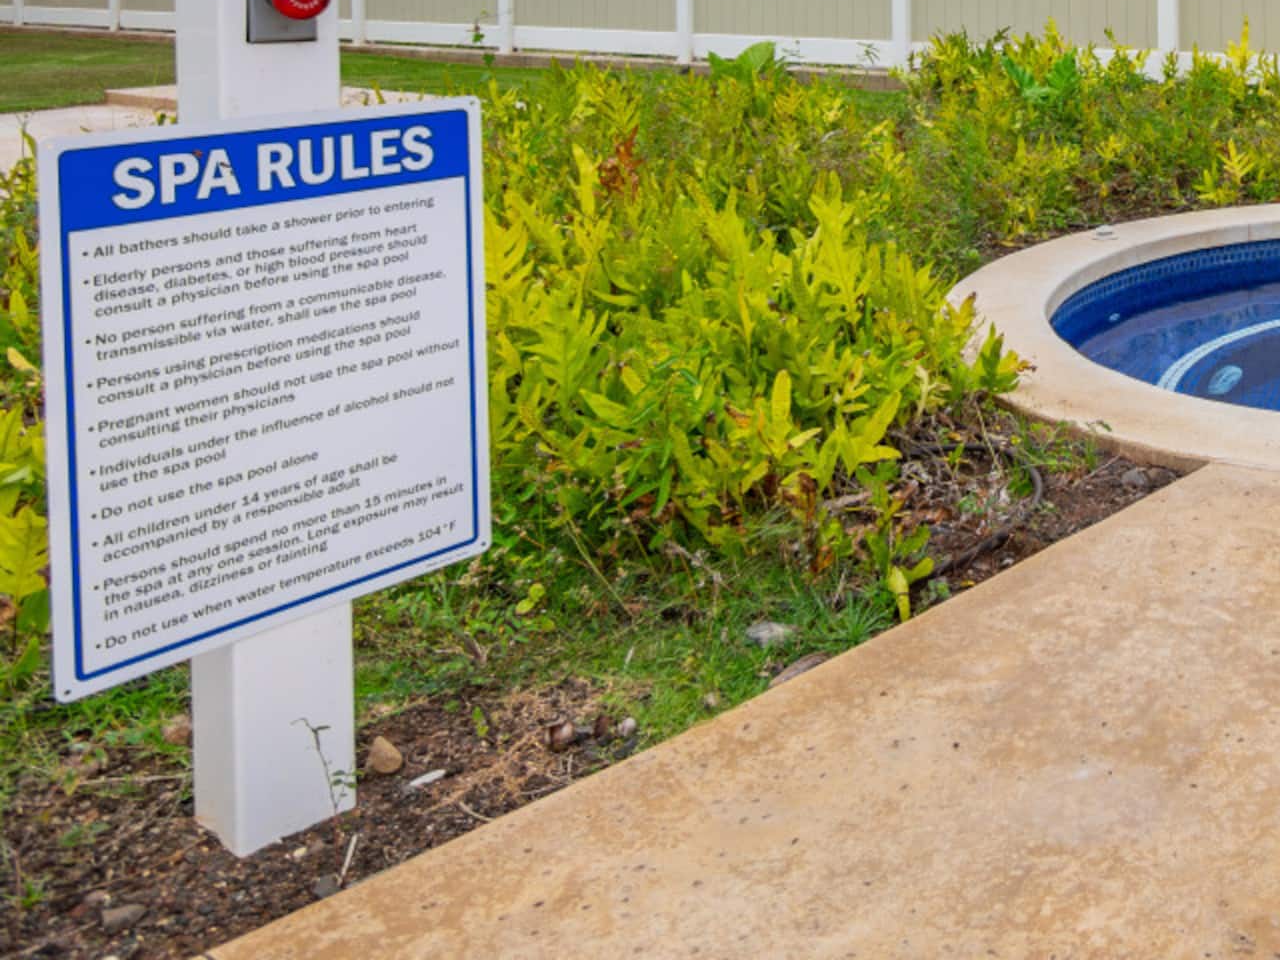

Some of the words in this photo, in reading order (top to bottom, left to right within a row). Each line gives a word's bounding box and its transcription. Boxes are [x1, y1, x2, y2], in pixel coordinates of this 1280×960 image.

[112, 149, 241, 209] SPA
[257, 126, 433, 191] RULES
[92, 268, 148, 288] Elderly
[151, 258, 212, 280] persons
[215, 251, 243, 267] and
[245, 246, 286, 261] those
[288, 234, 349, 255] suffering
[350, 230, 382, 243] from
[384, 223, 417, 238] heart
[93, 243, 115, 259] All
[118, 237, 179, 255] bathers
[181, 226, 233, 245] should
[235, 223, 268, 237] take
[271, 220, 281, 232] a
[283, 213, 333, 229] shower
[335, 207, 366, 223] prior
[367, 205, 382, 217] to
[383, 196, 435, 214] entering
[235, 266, 251, 278] or
[253, 259, 285, 275] high
[287, 251, 326, 269] blood
[328, 242, 385, 264] pressure
[387, 233, 428, 251] should
[93, 296, 153, 318] consult
[156, 296, 167, 307] a
[170, 282, 241, 307] physician
[243, 272, 290, 291] before
[292, 265, 330, 282] using
[331, 262, 354, 275] the
[356, 257, 380, 271] spa
[382, 250, 410, 267] pool
[94, 332, 118, 346] No
[121, 321, 176, 344] person
[179, 307, 246, 330] suffering
[248, 300, 283, 316] from
[285, 298, 296, 310] a
[297, 279, 395, 307] communicable
[95, 330, 202, 361] transmissible
[205, 326, 228, 339] via
[277, 307, 311, 325] shall
[313, 304, 337, 318] use
[339, 298, 362, 312] the
[364, 294, 388, 307] spa
[389, 286, 417, 303] pool
[96, 367, 161, 389] Persons
[164, 356, 206, 376] using
[209, 338, 294, 368] prescription
[296, 321, 377, 347] medications
[379, 309, 421, 329] should
[97, 381, 156, 405] consult
[159, 380, 170, 391] a
[173, 364, 244, 390] physician
[246, 352, 292, 372] before
[294, 343, 332, 361] using
[333, 339, 356, 352] the
[358, 333, 382, 347] spa
[384, 324, 411, 343] pool
[97, 406, 170, 433] Pregnant
[173, 393, 230, 415] women
[233, 379, 281, 401] should
[283, 374, 306, 389] not
[309, 369, 334, 383] use
[335, 363, 358, 377] the
[360, 357, 384, 371] spa
[386, 348, 414, 367] pool
[415, 338, 460, 357] without
[98, 419, 181, 449] consulting
[183, 410, 219, 428] their
[221, 392, 296, 421] physicians
[98, 447, 185, 476] Individuals
[187, 434, 231, 454] under
[233, 427, 259, 441] the
[261, 410, 325, 435] influence
[327, 403, 341, 417] of
[343, 391, 390, 414] alcohol
[391, 381, 433, 401] should
[434, 376, 455, 390] not
[99, 476, 129, 492] use
[132, 468, 159, 484] the
[162, 459, 191, 476] spa
[194, 447, 227, 470] pool
[100, 505, 124, 520] Do
[127, 495, 153, 512] not
[157, 488, 185, 504] use
[188, 480, 214, 496] the
[217, 472, 244, 488] spa
[247, 460, 278, 481] pool
[280, 451, 319, 470] alone
[102, 530, 124, 547] All
[127, 513, 191, 540] children
[193, 500, 237, 521] under
[241, 490, 261, 507] 14
[263, 481, 302, 503] years
[303, 473, 318, 489] of
[320, 469, 346, 484] age
[348, 456, 380, 476] shall
[381, 453, 398, 465] be
[102, 521, 208, 564] accompanied
[211, 517, 229, 531] by
[231, 513, 243, 525] a
[245, 488, 325, 521] responsible
[327, 476, 361, 496] adult
[103, 562, 168, 591] Persons
[170, 543, 221, 570] should
[223, 529, 268, 553] spend
[271, 525, 289, 539] no
[291, 512, 328, 532] more
[330, 503, 361, 520] than
[364, 495, 382, 510] 15
[383, 480, 433, 503] minutes
[435, 475, 448, 487] in
[103, 589, 131, 606] the
[134, 579, 164, 597] spa
[167, 571, 183, 586] at
[186, 563, 214, 580] any
[216, 553, 245, 570] one
[306, 521, 341, 542] Long
[342, 504, 400, 529] exposure
[402, 495, 429, 511] may
[431, 482, 464, 502] result
[103, 608, 120, 622] in
[188, 565, 255, 594] dizziness
[257, 558, 273, 571] or
[275, 539, 329, 565] fainting
[104, 634, 128, 649] Do
[131, 623, 158, 640] not
[161, 613, 189, 630] use
[191, 598, 233, 619] when
[235, 583, 277, 605] water
[279, 554, 362, 590] temperature
[364, 537, 415, 561] exceeds
